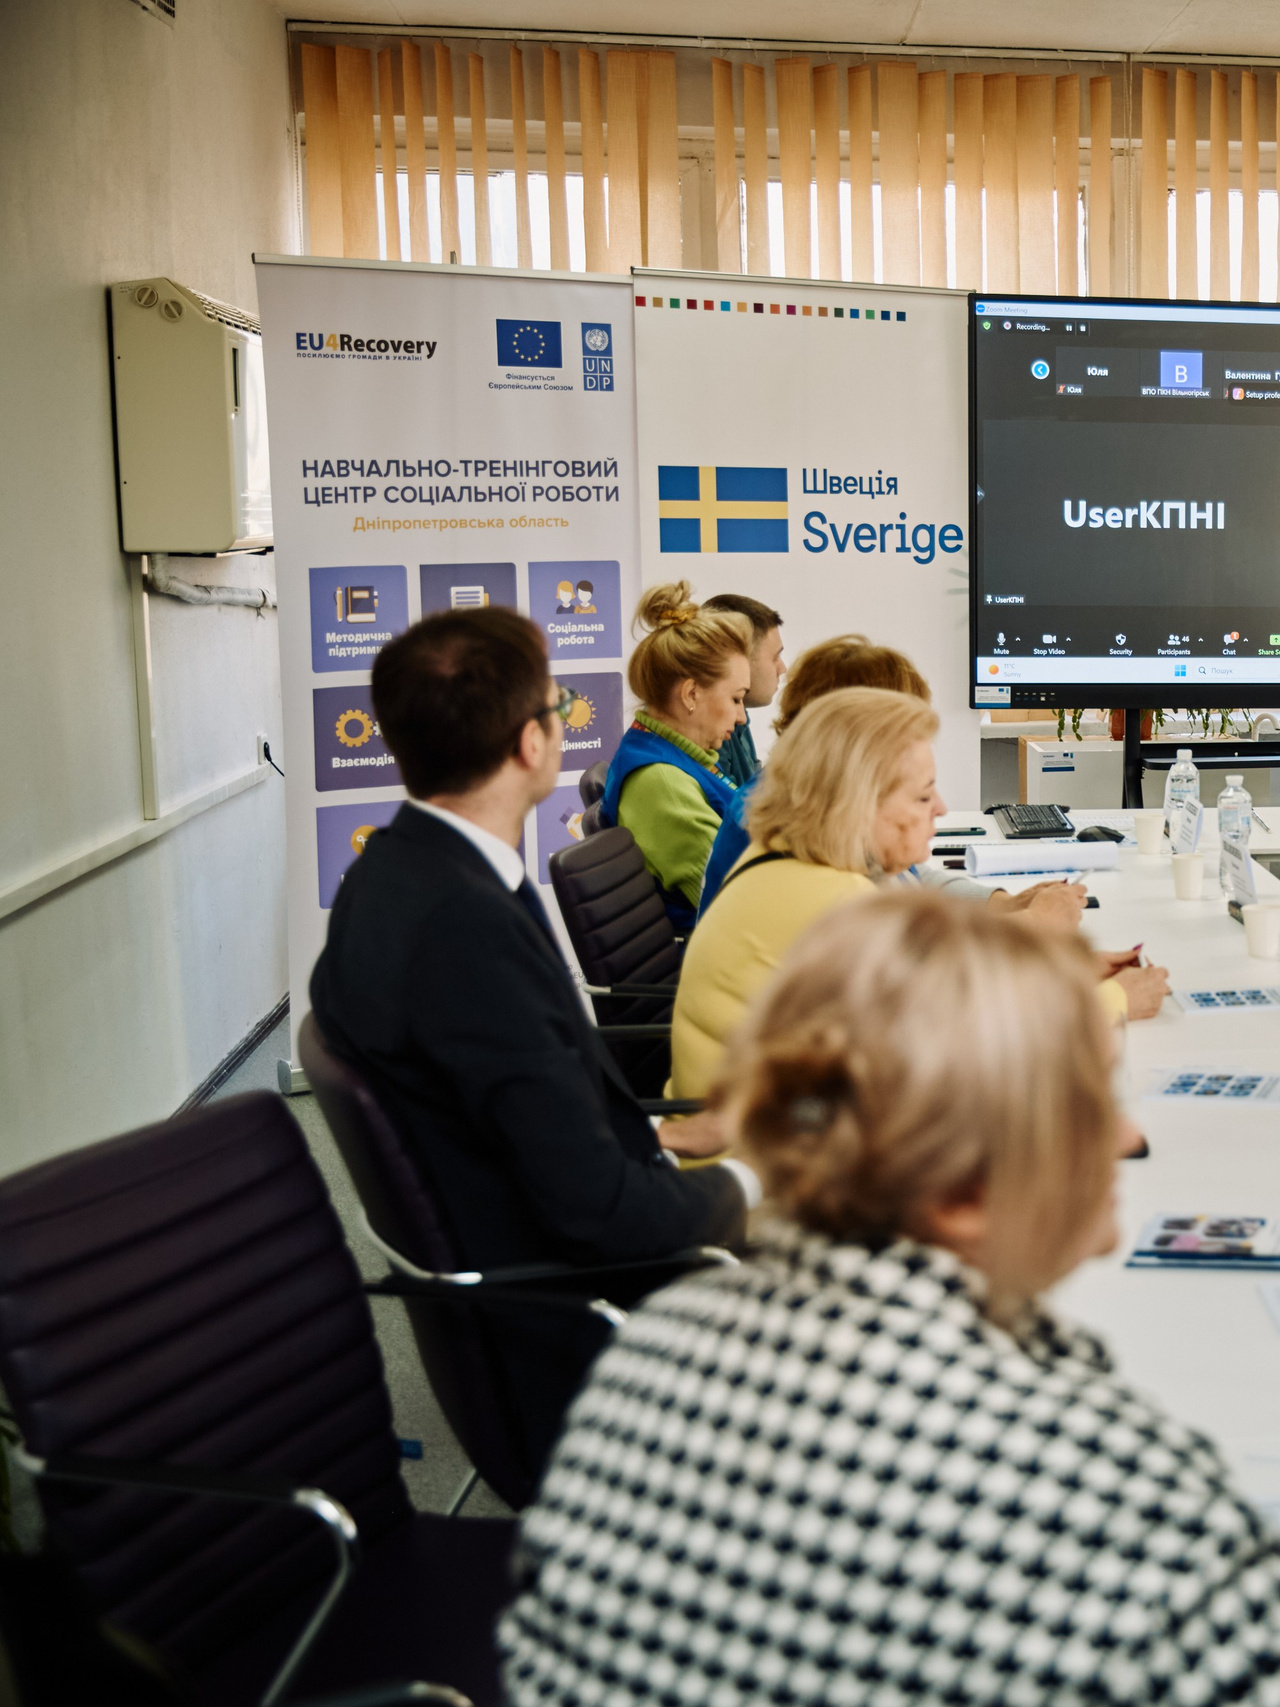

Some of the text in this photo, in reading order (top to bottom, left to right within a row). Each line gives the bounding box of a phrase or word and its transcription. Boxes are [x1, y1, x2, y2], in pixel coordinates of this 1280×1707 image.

[296, 332, 438, 359] EU4Recovery
[506, 373, 555, 382] Фінансується
[1087, 366, 1108, 377] Юля
[1225, 371, 1271, 381] Валентина
[488, 382, 573, 391] Європейським Союзом
[1246, 391, 1263, 400] Setup
[302, 457, 618, 478] НАВЧАЛЬНО-ТРЕНІНГОВИЙ
[802, 468, 898, 499] Швеція
[303, 482, 620, 507] ЦЕНТР СОЦІАЛЬНОЇ РОБОТИ
[353, 515, 569, 532] Дніпропетровська область
[803, 511, 964, 564] Sverige
[548, 622, 605, 634] Соціальна
[326, 631, 392, 644] Методична
[557, 635, 594, 648] робота
[1181, 635, 1190, 643] 46
[329, 644, 382, 658] підтрим
[1033, 648, 1047, 656] Stop
[1109, 648, 1133, 657] Security
[1157, 648, 1191, 657] Participants
[1222, 648, 1236, 656] Chat
[332, 753, 395, 769] Взаємодія
